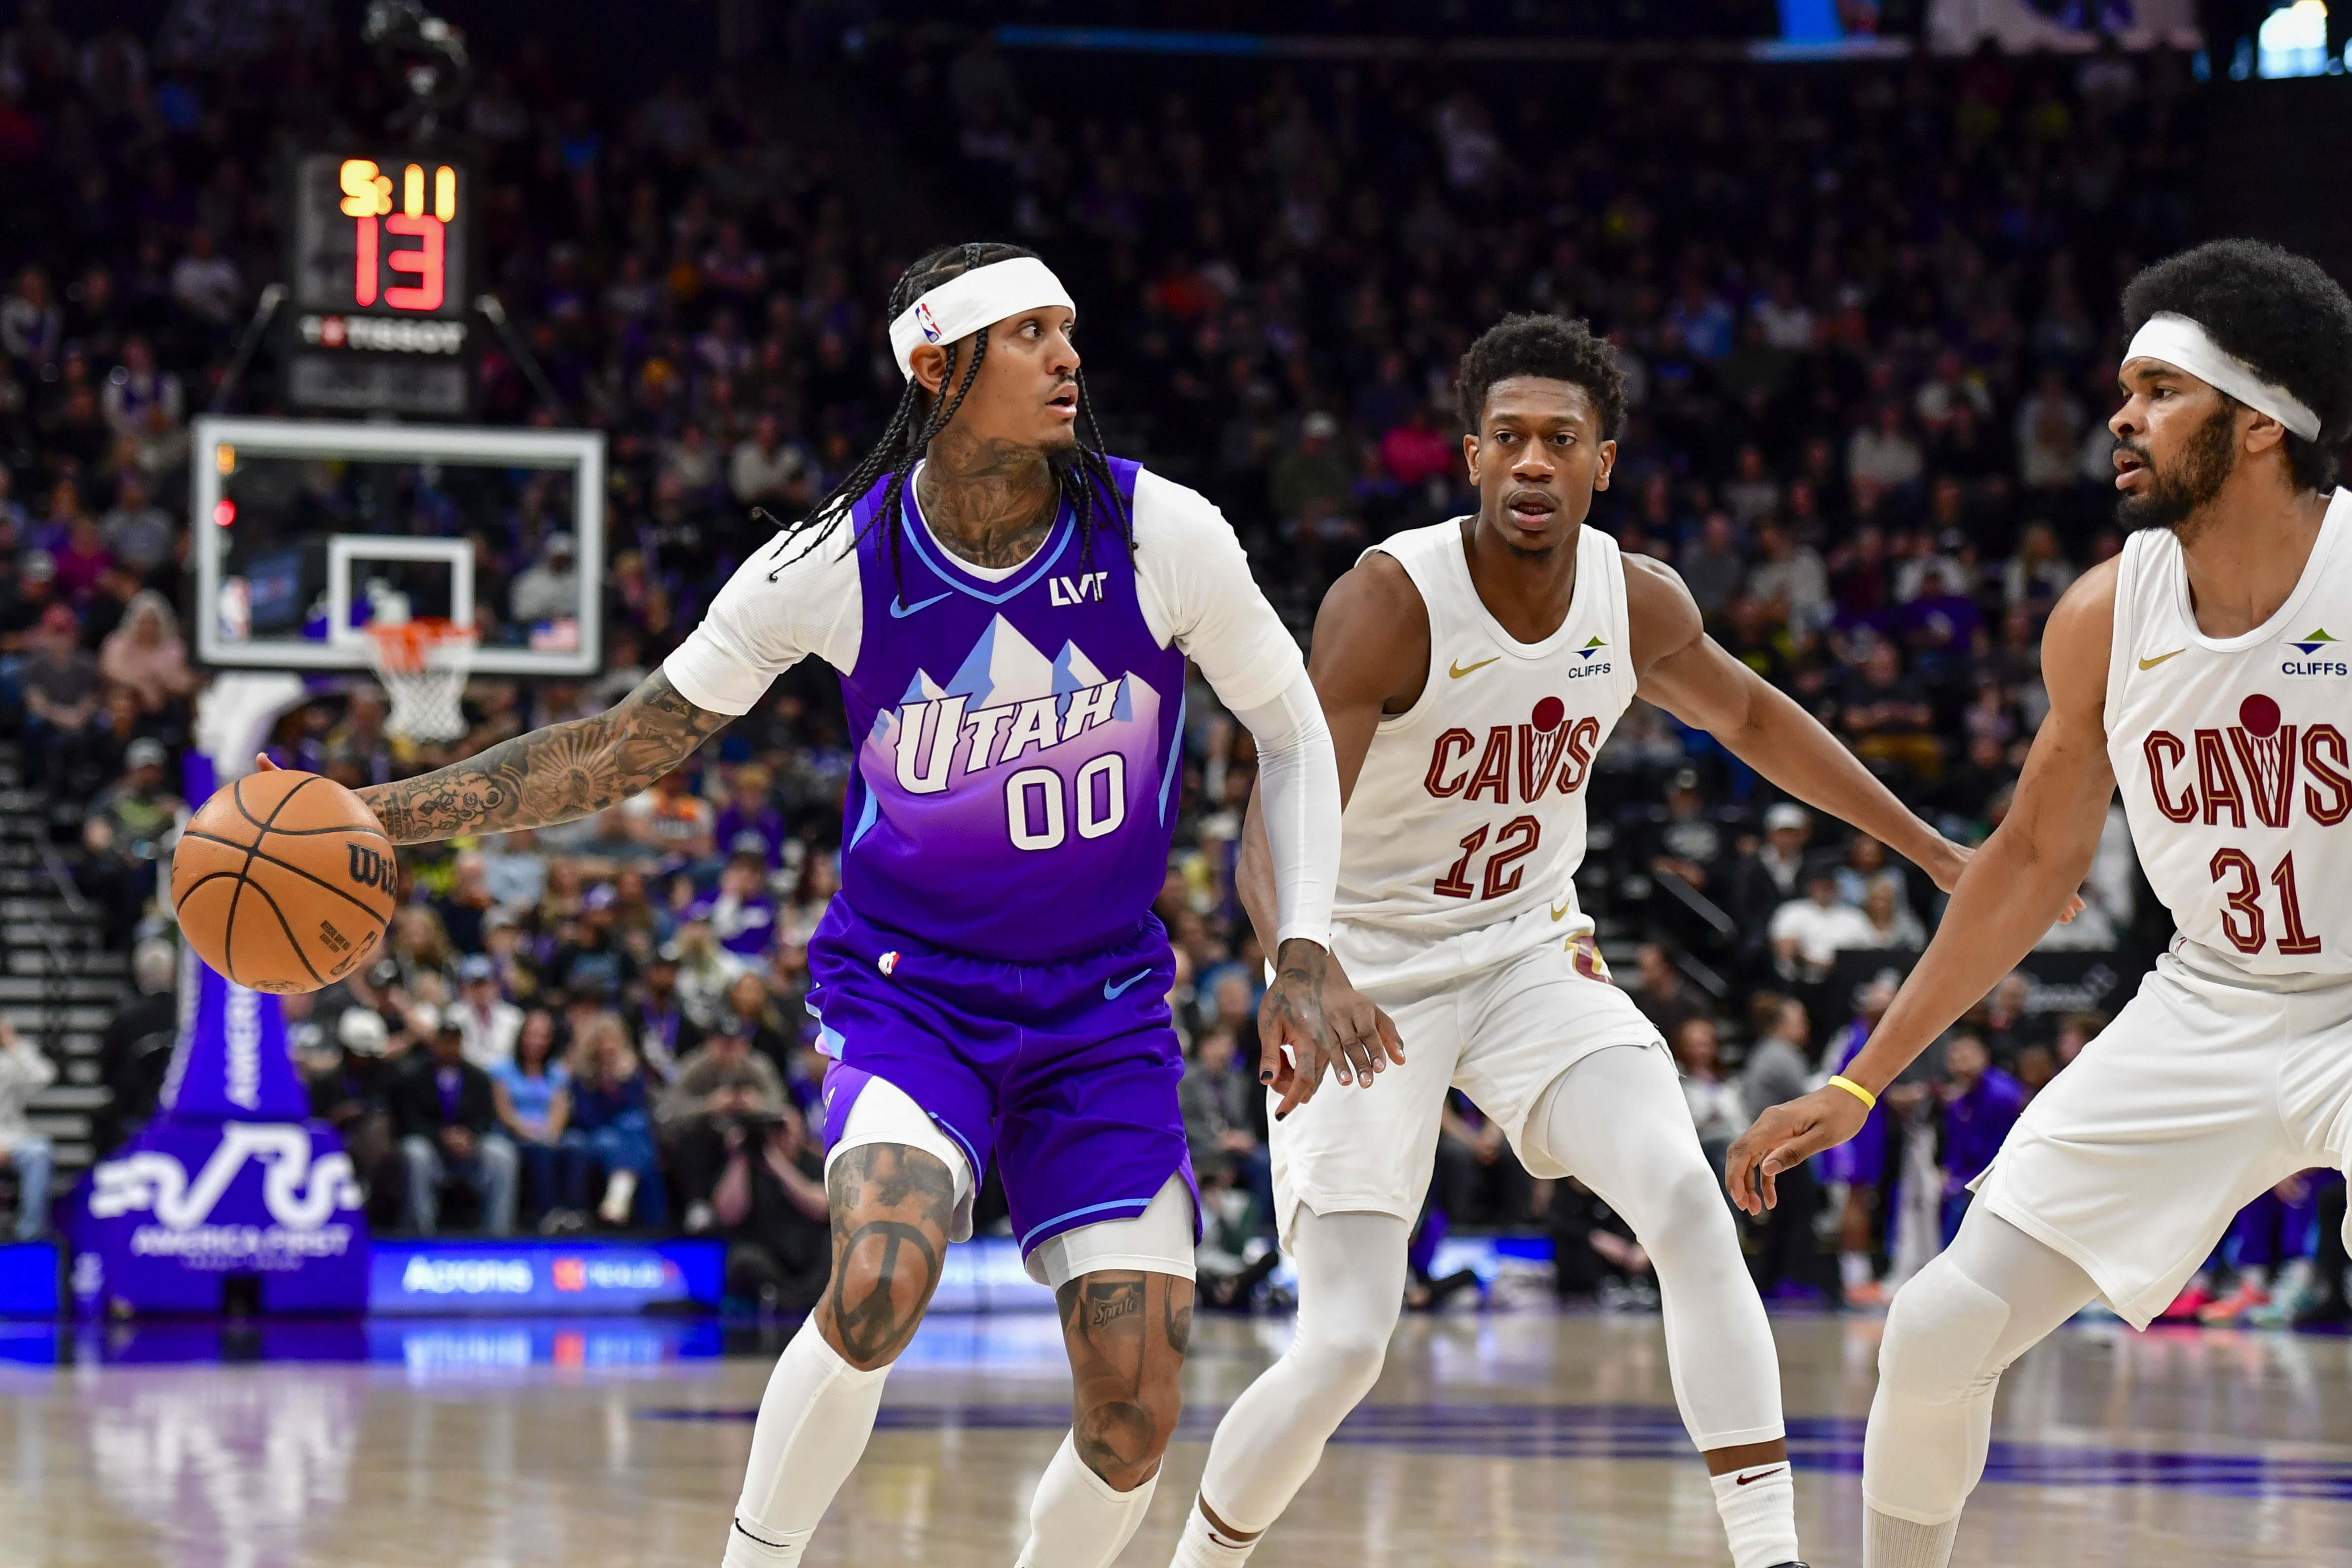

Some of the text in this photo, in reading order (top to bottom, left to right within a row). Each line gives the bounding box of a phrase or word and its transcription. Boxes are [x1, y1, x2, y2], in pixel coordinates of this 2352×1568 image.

[340, 159, 456, 222] 5:11
[356, 213, 445, 310] 13
[1049, 571, 1108, 606] LVT
[1568, 663, 1611, 679] CLIFFS
[2281, 661, 2348, 677] CLIFFS
[1004, 751, 1127, 852] 00
[1424, 716, 1600, 804] CAVS
[2143, 723, 2352, 829] CAVS
[1433, 815, 1541, 900] 12
[2209, 847, 2322, 955] 31
